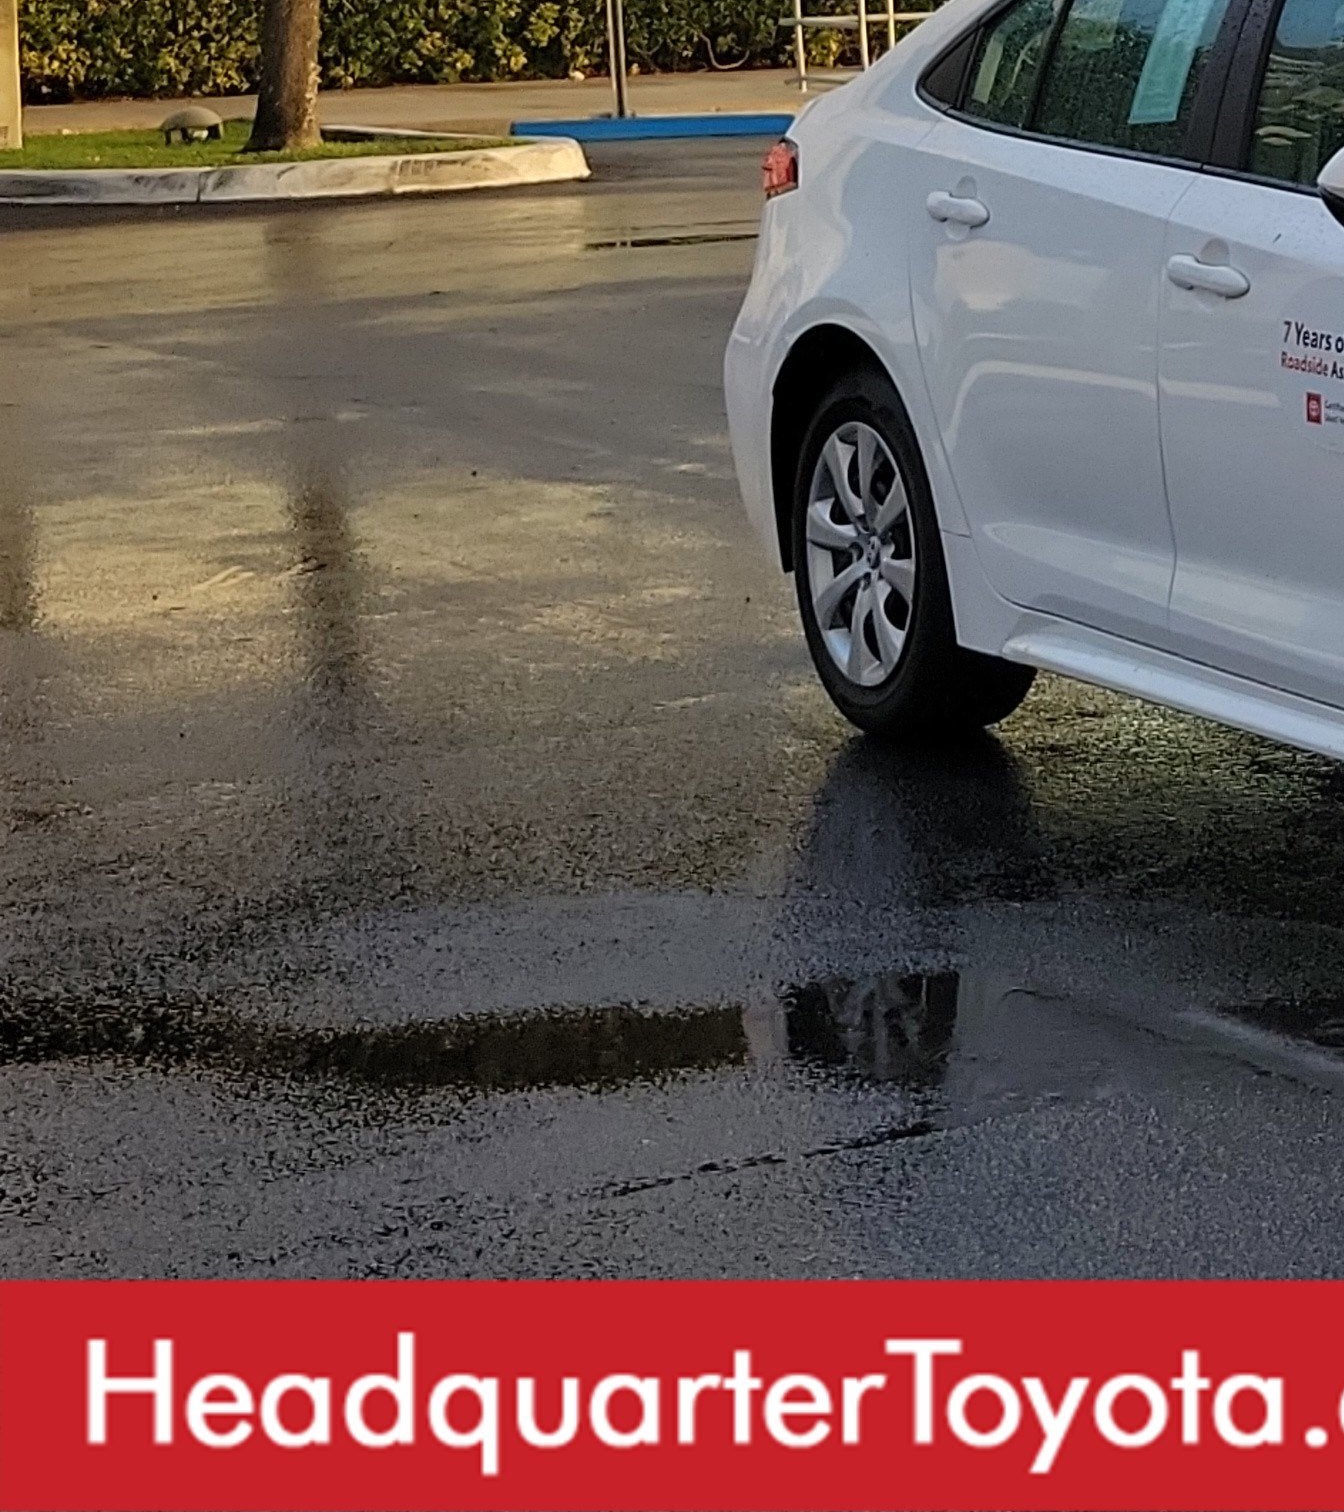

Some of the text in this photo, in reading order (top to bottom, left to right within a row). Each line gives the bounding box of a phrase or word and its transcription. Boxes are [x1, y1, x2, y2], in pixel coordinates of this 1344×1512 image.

[1284, 321, 1293, 343] 7
[1295, 321, 1332, 351] Years
[1281, 351, 1329, 377] Roadside
